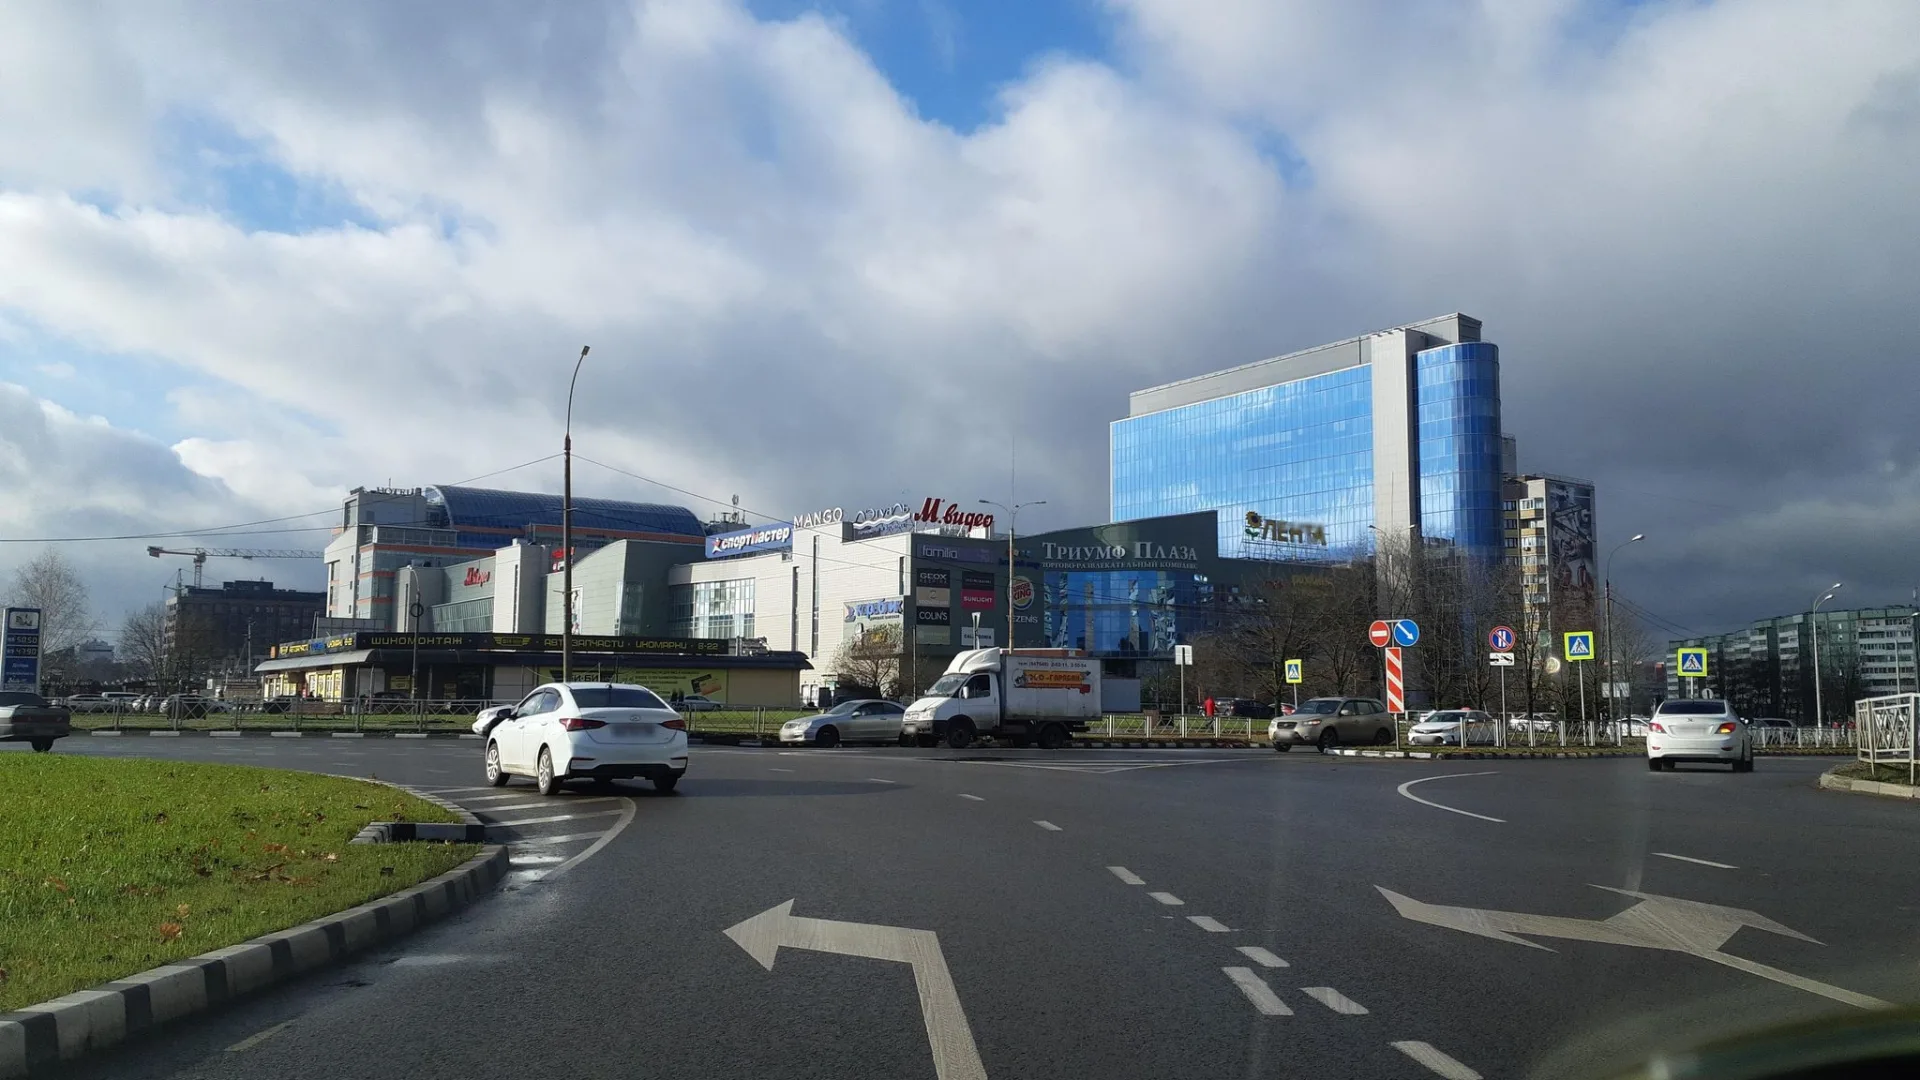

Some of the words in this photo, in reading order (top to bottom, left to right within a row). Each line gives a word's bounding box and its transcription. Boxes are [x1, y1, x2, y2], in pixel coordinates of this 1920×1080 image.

[793, 507, 843, 529] MANGO
[720, 527, 791, 550] спортмастер
[922, 544, 958, 559] familia
[920, 572, 948, 580] GEOX
[919, 612, 948, 621] COLIN'S
